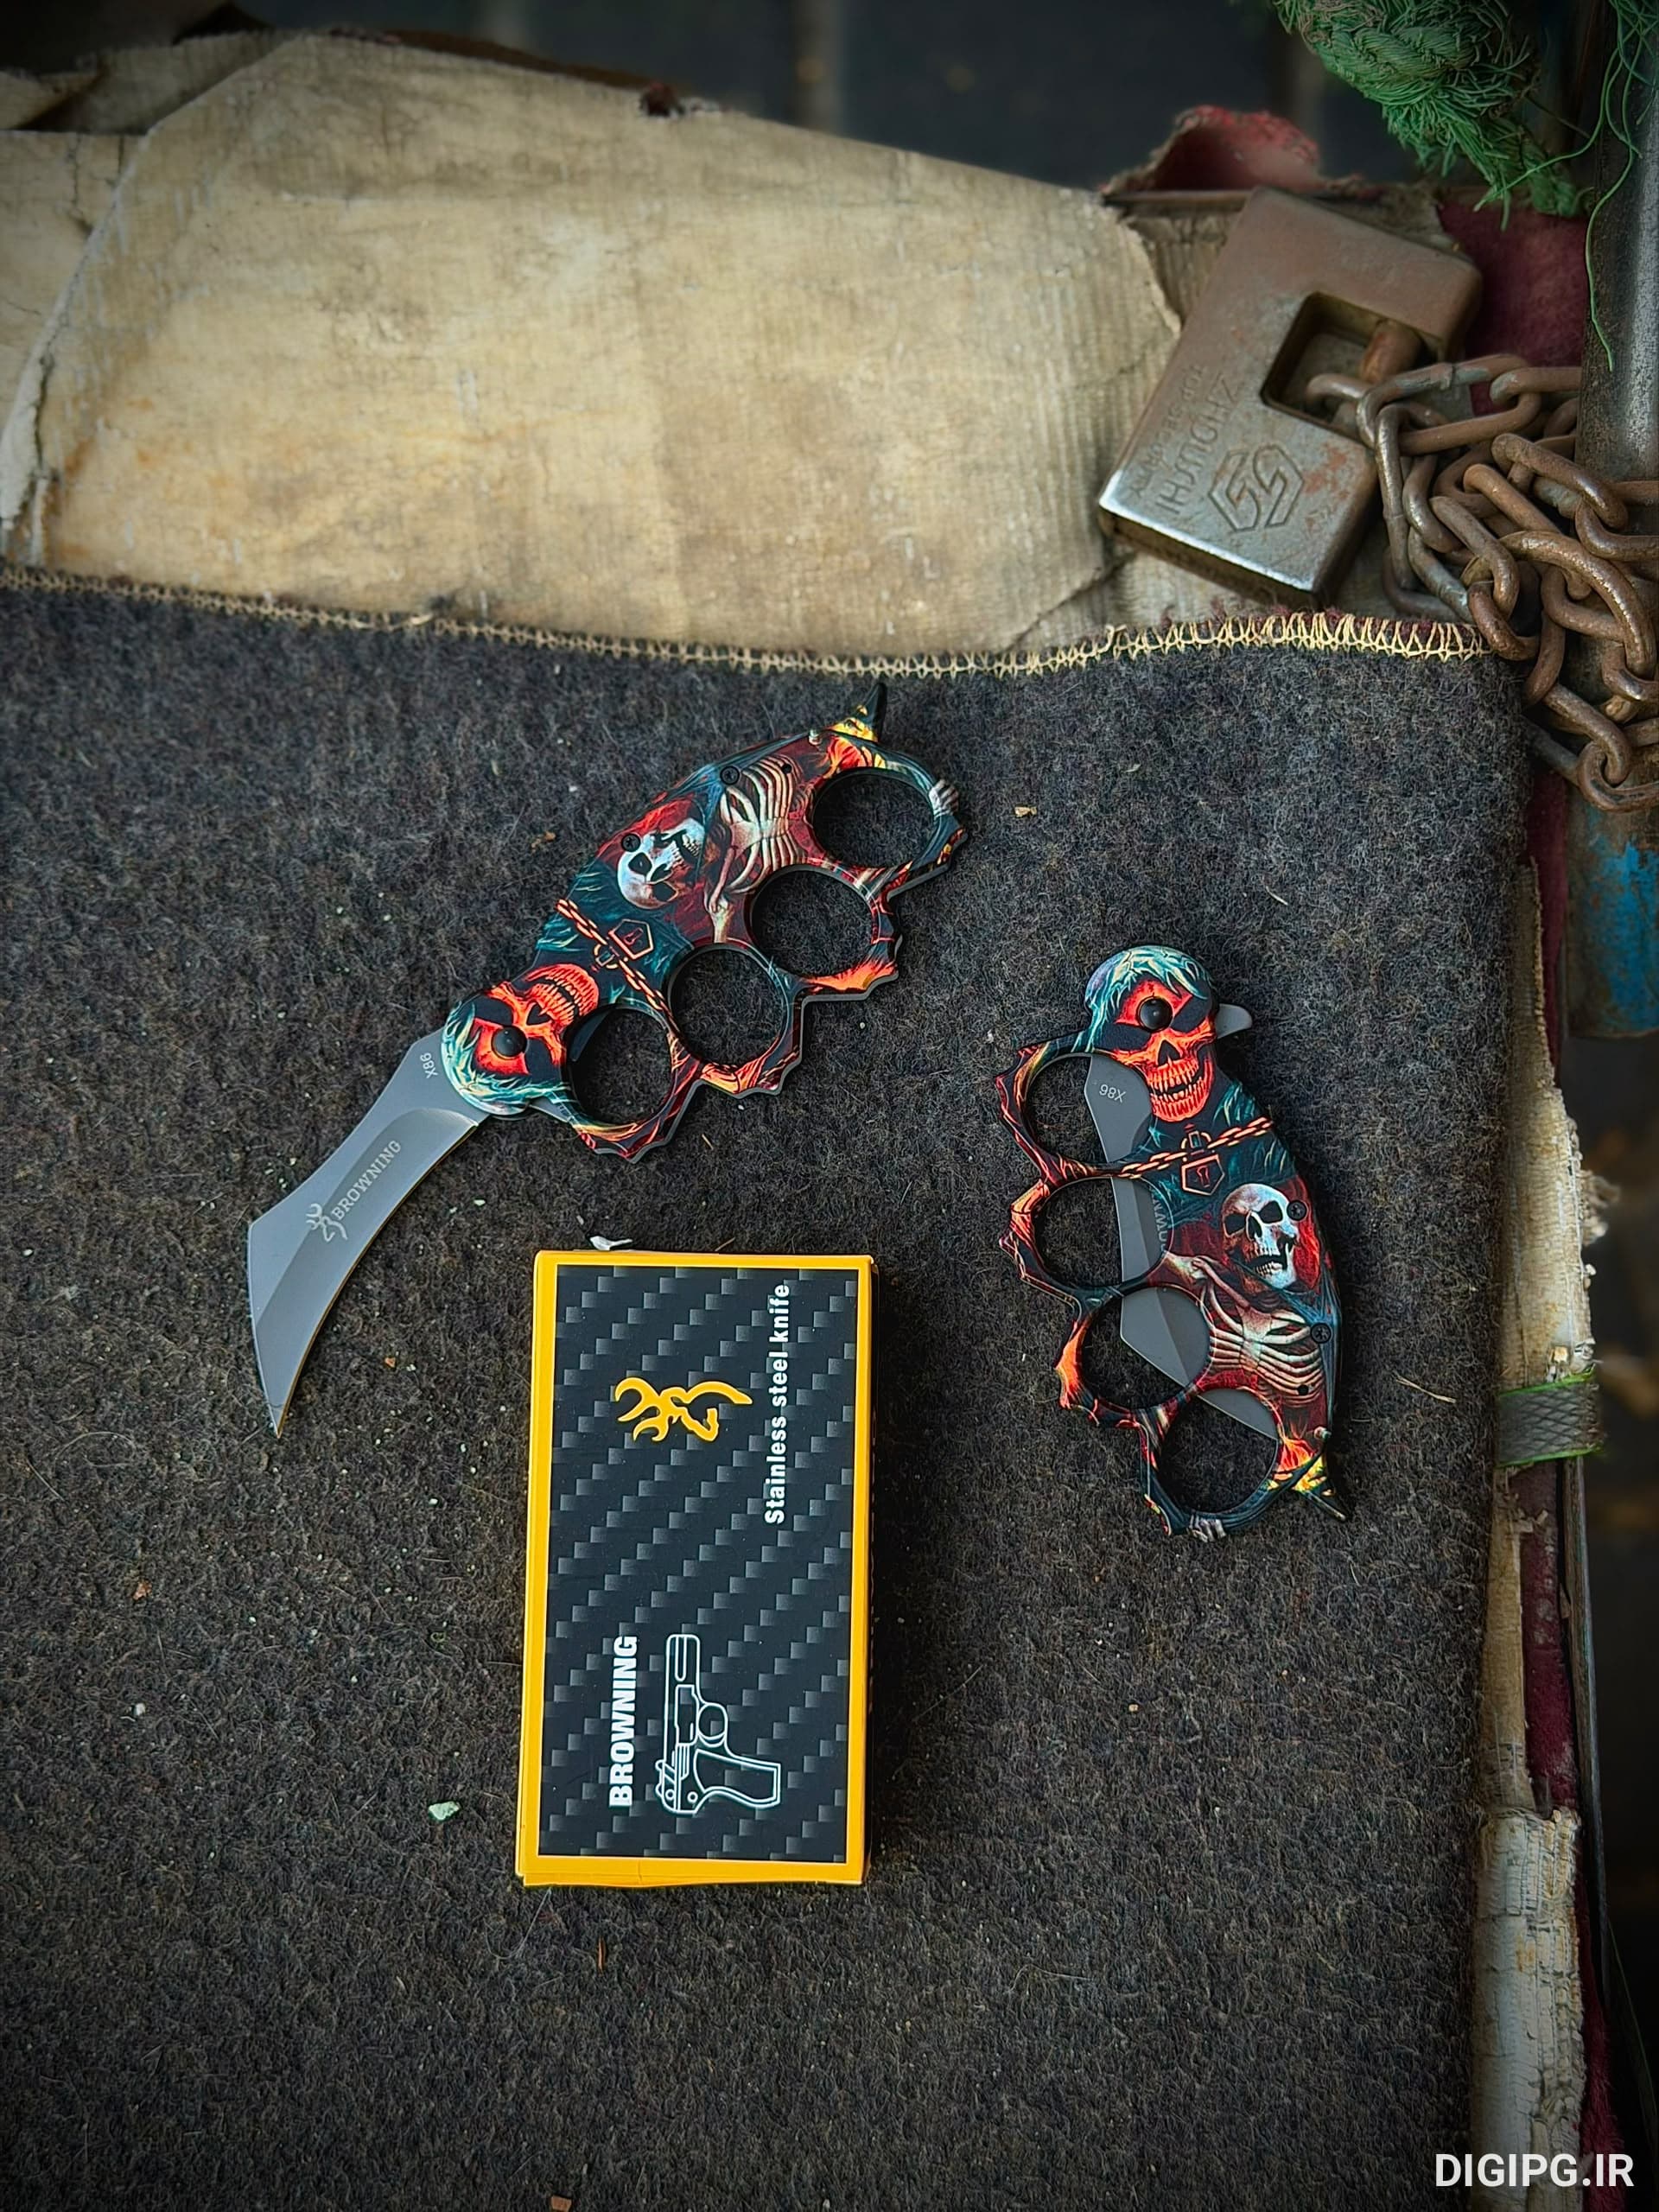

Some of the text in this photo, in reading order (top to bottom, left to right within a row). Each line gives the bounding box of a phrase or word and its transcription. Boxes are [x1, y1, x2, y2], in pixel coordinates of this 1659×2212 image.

[331, 1140, 402, 1221] BROWNING
[765, 1284, 790, 1524] Stainless steel knife
[609, 1636, 638, 1807] BROWNING
